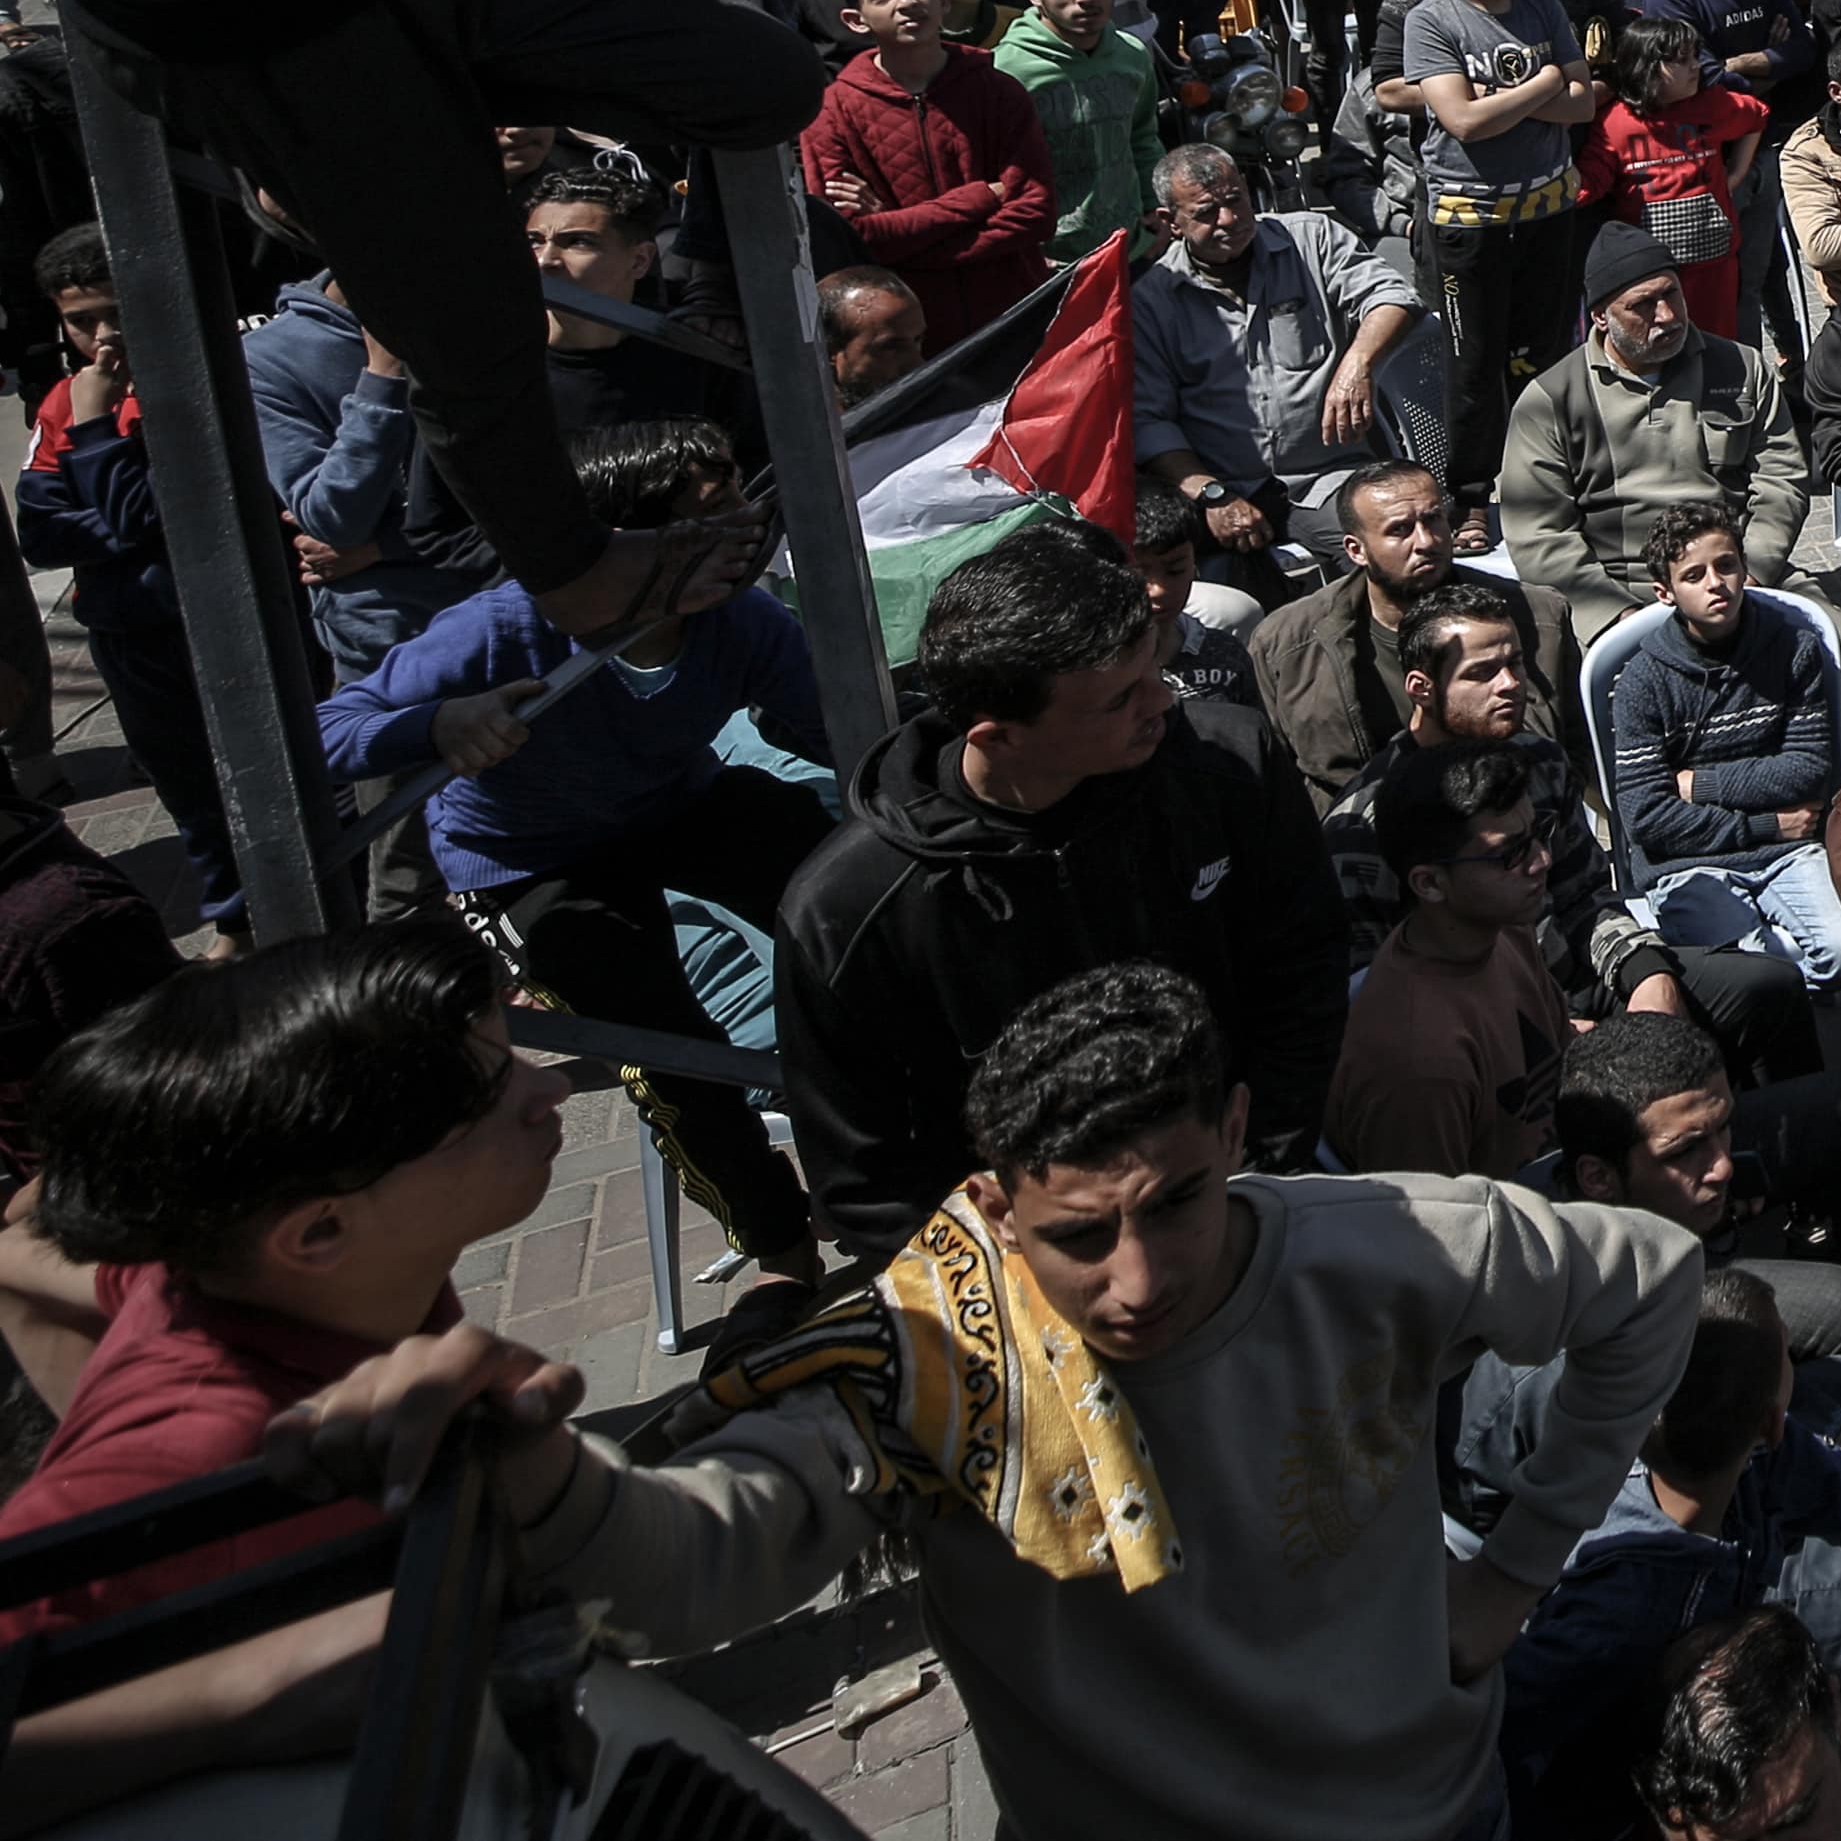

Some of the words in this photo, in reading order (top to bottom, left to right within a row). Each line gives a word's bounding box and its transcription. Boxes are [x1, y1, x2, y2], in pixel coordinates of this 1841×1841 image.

[1726, 6, 1765, 28] ADIDAS
[1192, 668, 1237, 686] BOY
[1199, 856, 1233, 888] NIKE
